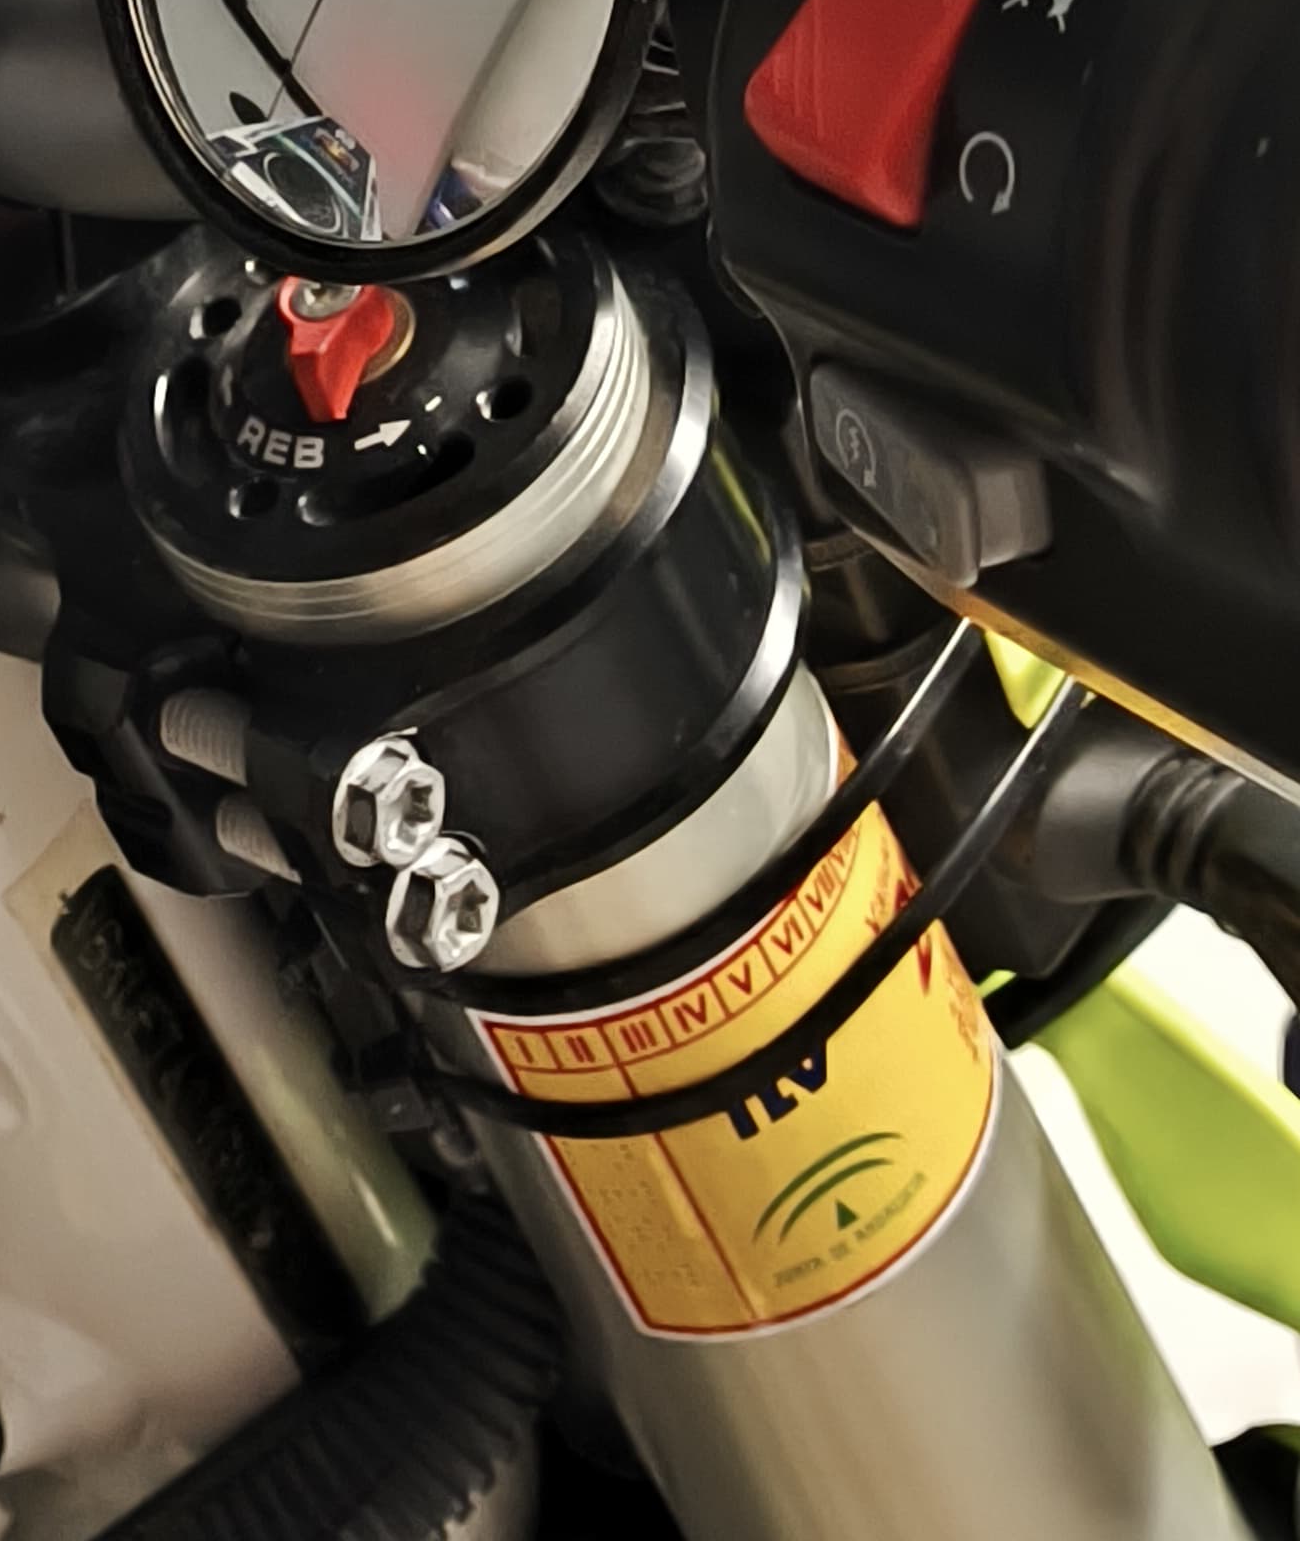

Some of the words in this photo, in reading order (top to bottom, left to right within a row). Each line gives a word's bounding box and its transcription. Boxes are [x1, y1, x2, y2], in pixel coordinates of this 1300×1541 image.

[237, 416, 325, 469] REB
[514, 1035, 534, 1064] I
[565, 1035, 597, 1064] II
[619, 1019, 658, 1054] III
[672, 993, 708, 1034] IV
[727, 962, 753, 996] V
[770, 922, 805, 955] VI
